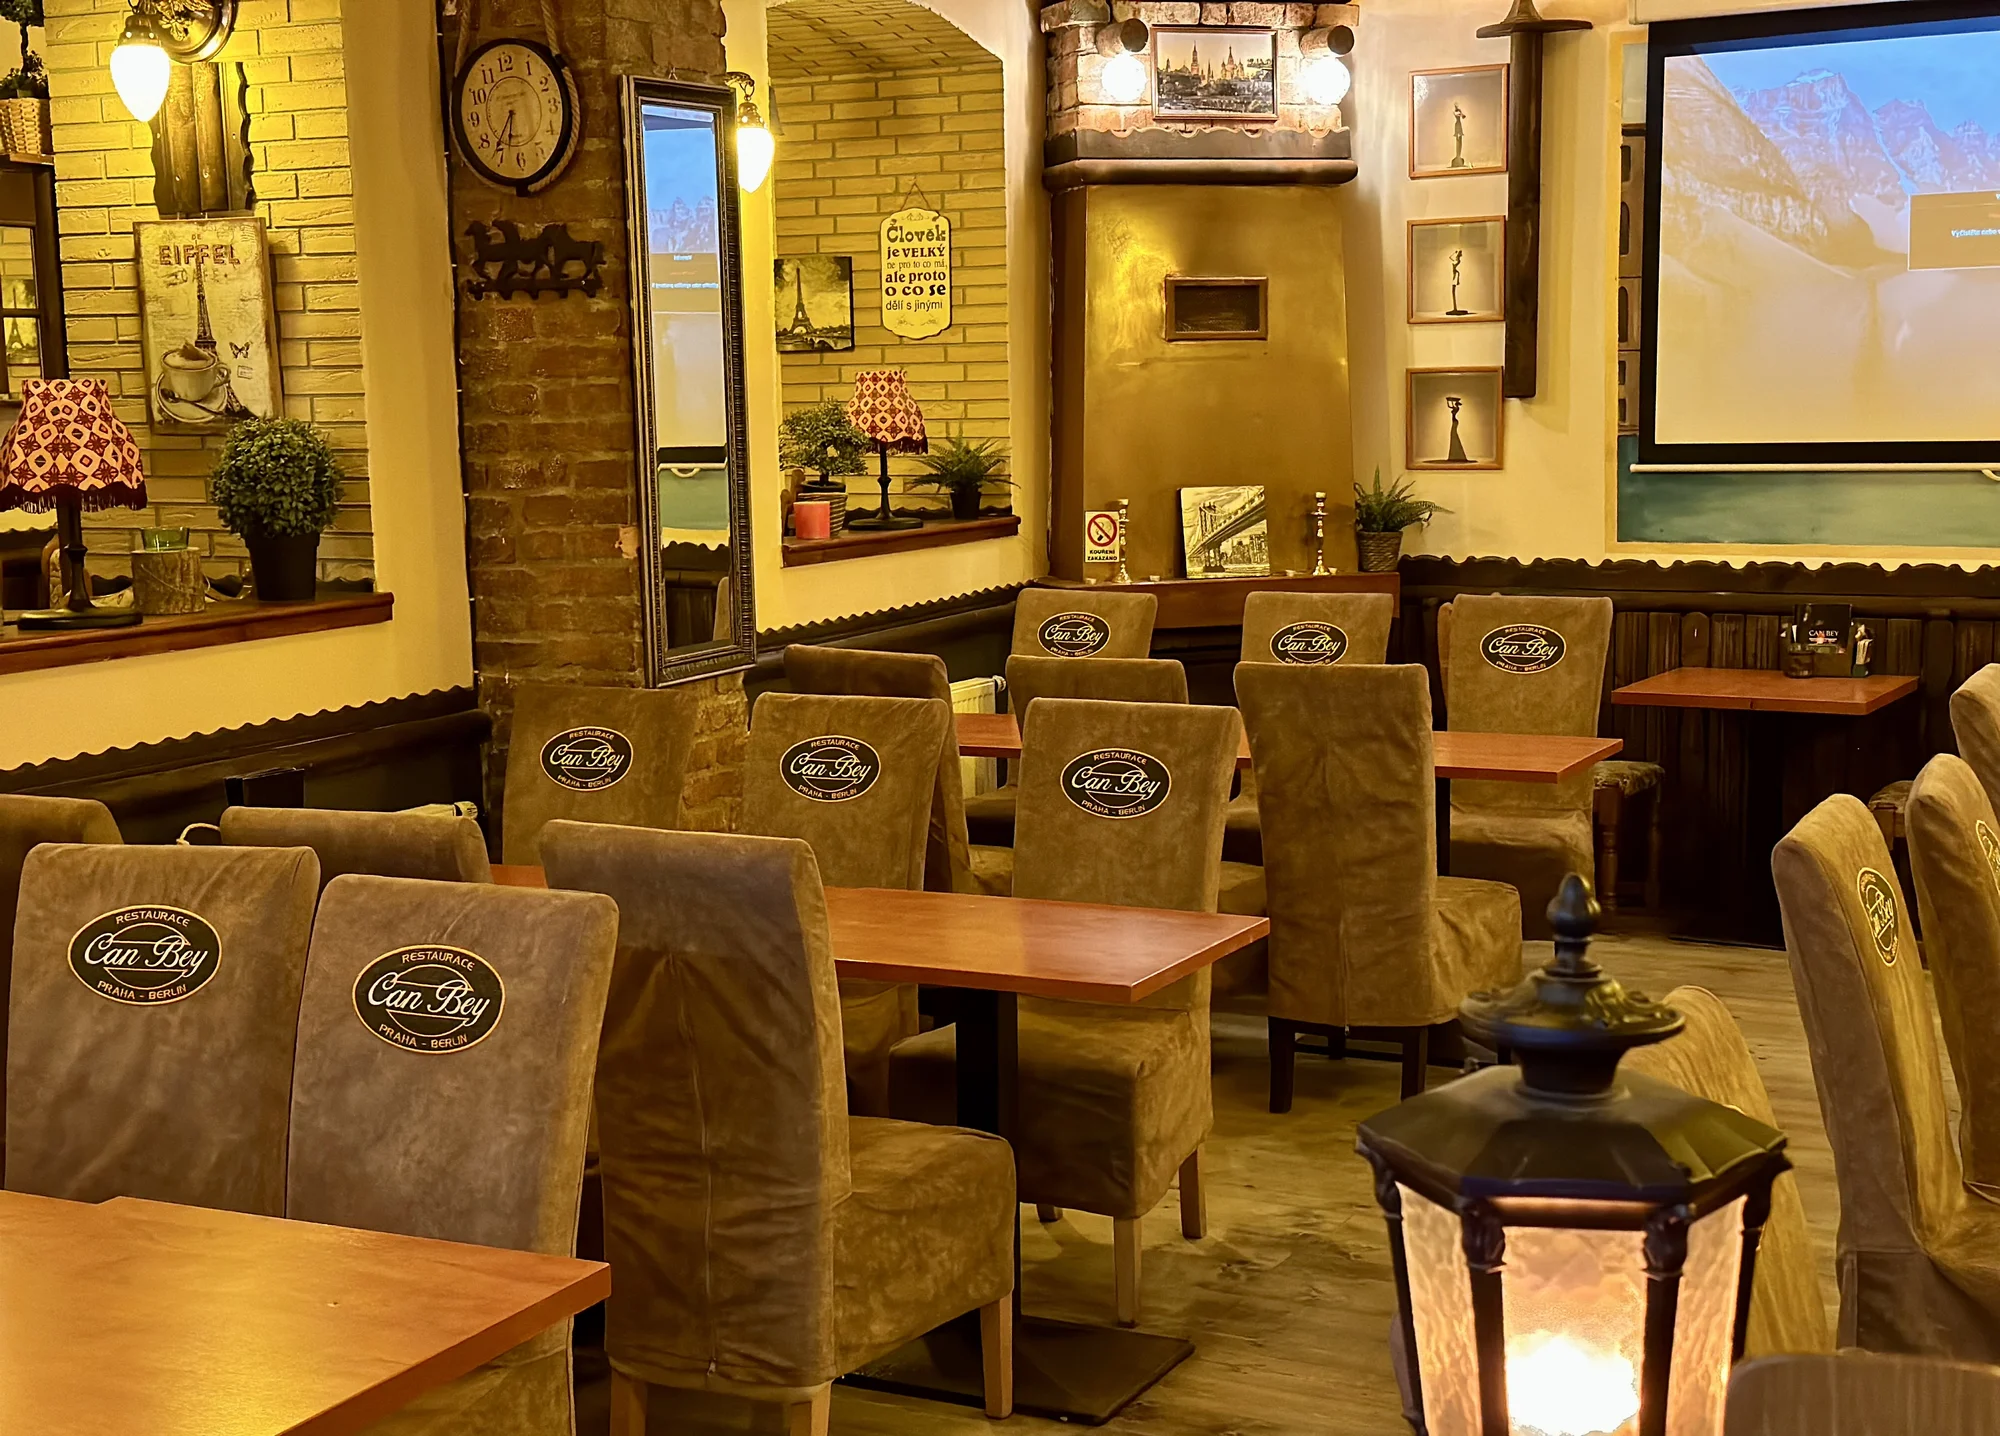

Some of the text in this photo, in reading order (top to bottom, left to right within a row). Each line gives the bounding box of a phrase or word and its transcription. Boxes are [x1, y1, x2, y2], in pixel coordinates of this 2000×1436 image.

[497, 52, 513, 72] 12
[481, 64, 494, 84] 11
[539, 73, 552, 92] 2
[468, 87, 486, 105] 10
[547, 97, 561, 113] 3
[467, 112, 480, 127] 9
[478, 133, 490, 150] 8
[516, 152, 526, 171] 6
[887, 222, 946, 243] Člověk
[159, 244, 241, 266] EIFFEL
[887, 244, 946, 260] je VELKÝ
[899, 261, 911, 271] pro
[885, 271, 946, 284] ale proto
[885, 284, 946, 296] o co se
[886, 299, 943, 312] dělí s jinými
[1044, 624, 1104, 646] Can Bey
[1277, 634, 1341, 656] Can Bey
[1488, 637, 1558, 660] Can Bey
[569, 730, 614, 741] RESTAURACE
[811, 738, 860, 751] RESTAURACE
[549, 744, 625, 774] Can Bey
[1093, 751, 1147, 766] RESTAURACE
[790, 752, 872, 785] Can Bey
[798, 784, 823, 799] PRAHA
[1071, 766, 1161, 801] Can Bey
[1081, 799, 1109, 815] PRAHA
[115, 910, 190, 928] RESTAURACE
[84, 932, 209, 978] Can Bey
[402, 951, 475, 972] RESTAURACE
[97, 980, 135, 1000] PRAHA
[148, 983, 187, 1000] BERLIN
[368, 971, 491, 1027] Can Bey
[379, 1023, 417, 1047] PRAHA
[430, 1033, 468, 1049] BERLIN
